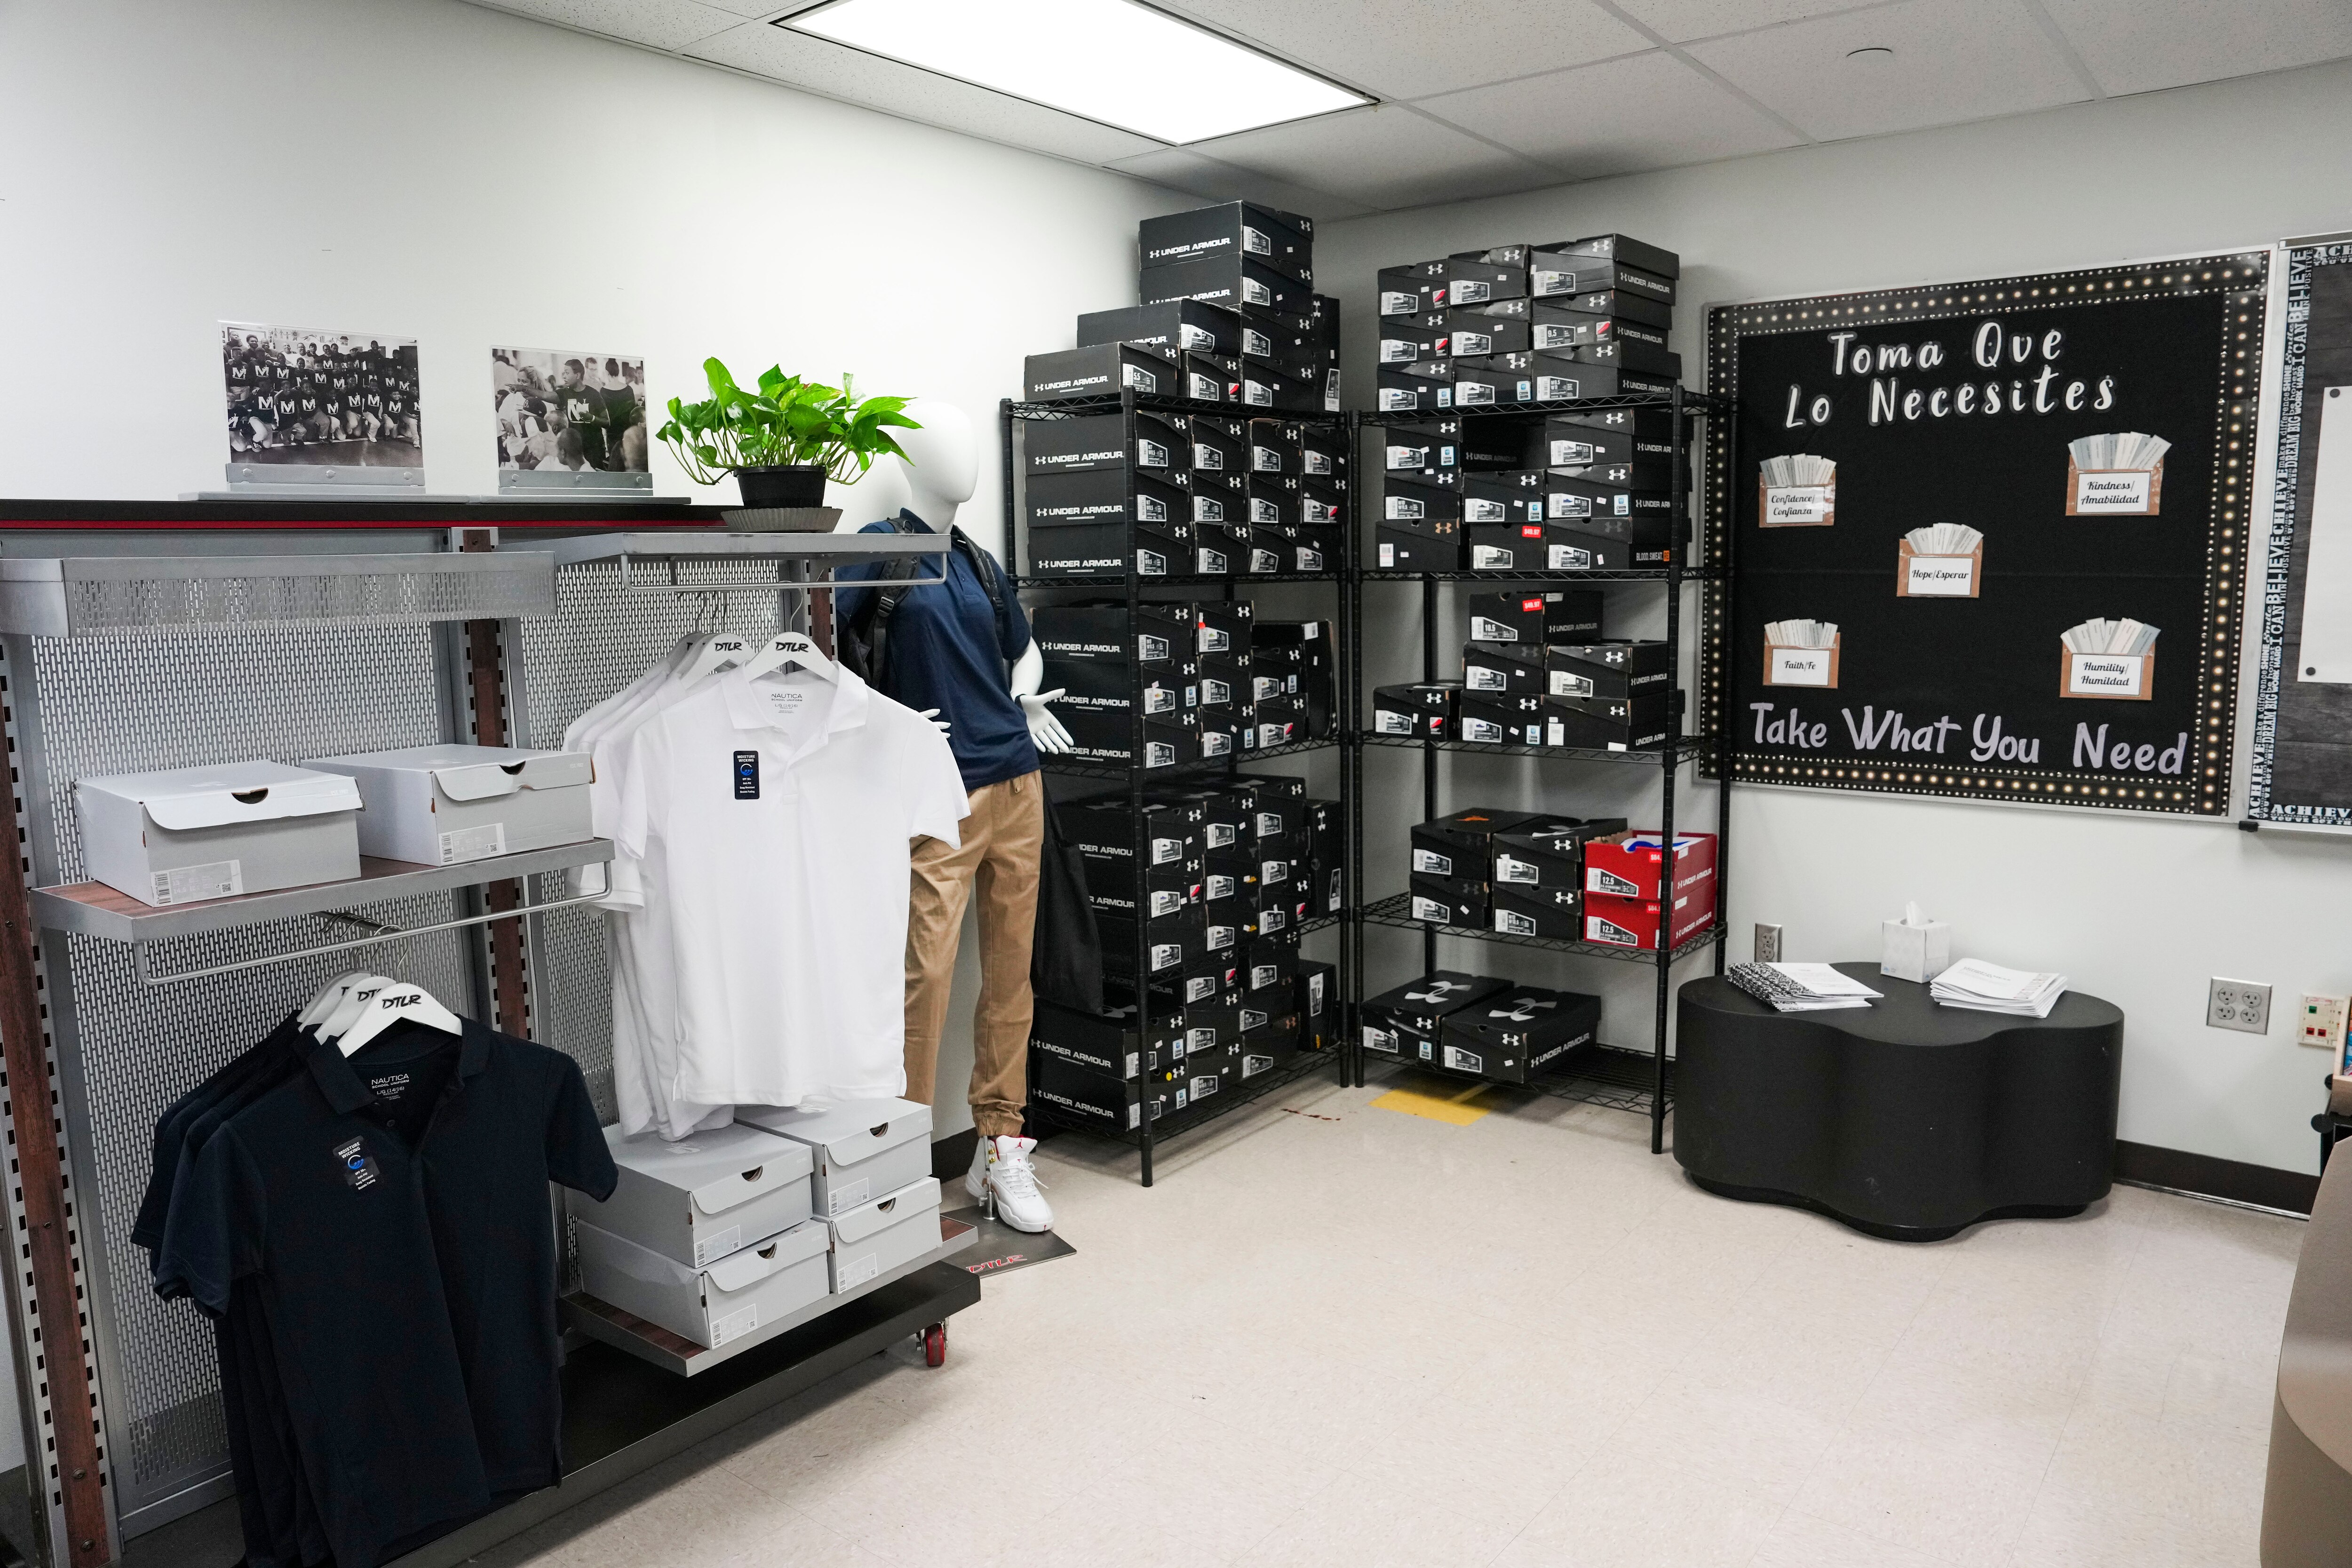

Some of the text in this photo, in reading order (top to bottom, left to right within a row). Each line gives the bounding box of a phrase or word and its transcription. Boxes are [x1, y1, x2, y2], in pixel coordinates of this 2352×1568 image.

[1160, 245, 1190, 256] UNDER
[1192, 238, 1230, 251] ARMOUR
[2304, 249, 2313, 288] POSITIVE
[1628, 275, 1670, 294] UNDER ARMOUR
[2288, 250, 2306, 323] BELIEVE
[1548, 329, 1557, 338] 9.5
[1624, 328, 1662, 344] UNDER ARMOUR
[2293, 324, 2307, 354] CAN
[2285, 323, 2294, 361] Smile
[1831, 333, 1943, 375] Toma
[1045, 375, 1108, 390] UNDER ARMOUR
[2283, 365, 2292, 391] SHINE
[1630, 382, 1648, 391] UNDER
[2294, 365, 2305, 415] WORK HARD
[1787, 365, 2114, 428] Lo Necesites
[2280, 392, 2291, 436] difference
[2285, 416, 2301, 469] DREAM BIG
[1048, 451, 1124, 463] UNDER ARMOUR
[2087, 480, 2135, 492] Kindness/
[1772, 494, 1815, 505] Confidence/
[2081, 495, 2139, 505] Amabilidad
[1082, 505, 1123, 514] ARMOUR
[1773, 508, 1812, 517] Confianza
[2282, 535, 2291, 573] POSITIVE
[1912, 570, 1968, 581] Hope/Esperar
[2266, 536, 2284, 605] BELIEVE
[2263, 605, 2273, 644] Smile
[2271, 605, 2285, 635] CAN
[715, 642, 742, 652] DTLR
[776, 642, 809, 653] DTLR
[1083, 644, 1120, 653] ARMOUR
[2260, 644, 2270, 670] SHINE
[1785, 661, 1816, 672] Faith/Fe
[2083, 662, 2129, 675] Humility/
[1636, 675, 1650, 685] UNDER
[2081, 676, 2129, 686] Humildad
[2271, 668, 2280, 693] WORK
[2258, 670, 2268, 712] difference
[1091, 698, 1129, 707] ARMOUR
[2262, 693, 2278, 744] DREAM BIG
[1636, 735, 1653, 746] UNDER
[1749, 702, 2187, 774] Take What You Need
[1091, 748, 1130, 758] ARMOUR
[2249, 743, 2265, 819] ACHIEVE
[1100, 844, 1133, 856] ARMOU
[1602, 876, 1614, 885] 12.5
[1097, 897, 1135, 908] ARMOUR
[1602, 925, 1614, 934] 12.5
[382, 994, 421, 1009] DTLR
[1042, 1042, 1071, 1056] UNDER
[1073, 1051, 1111, 1068] ARMOUR
[1540, 1033, 1589, 1062] UNDER ARMOUR
[372, 1074, 409, 1085] NAUTICA
[1043, 1092, 1073, 1106] UNDER
[1075, 1102, 1114, 1118] ARMOUR
[338, 1141, 360, 1155] MOISTURE
[341, 1146, 361, 1158] WICKING
[966, 1255, 1027, 1273] DTLR
